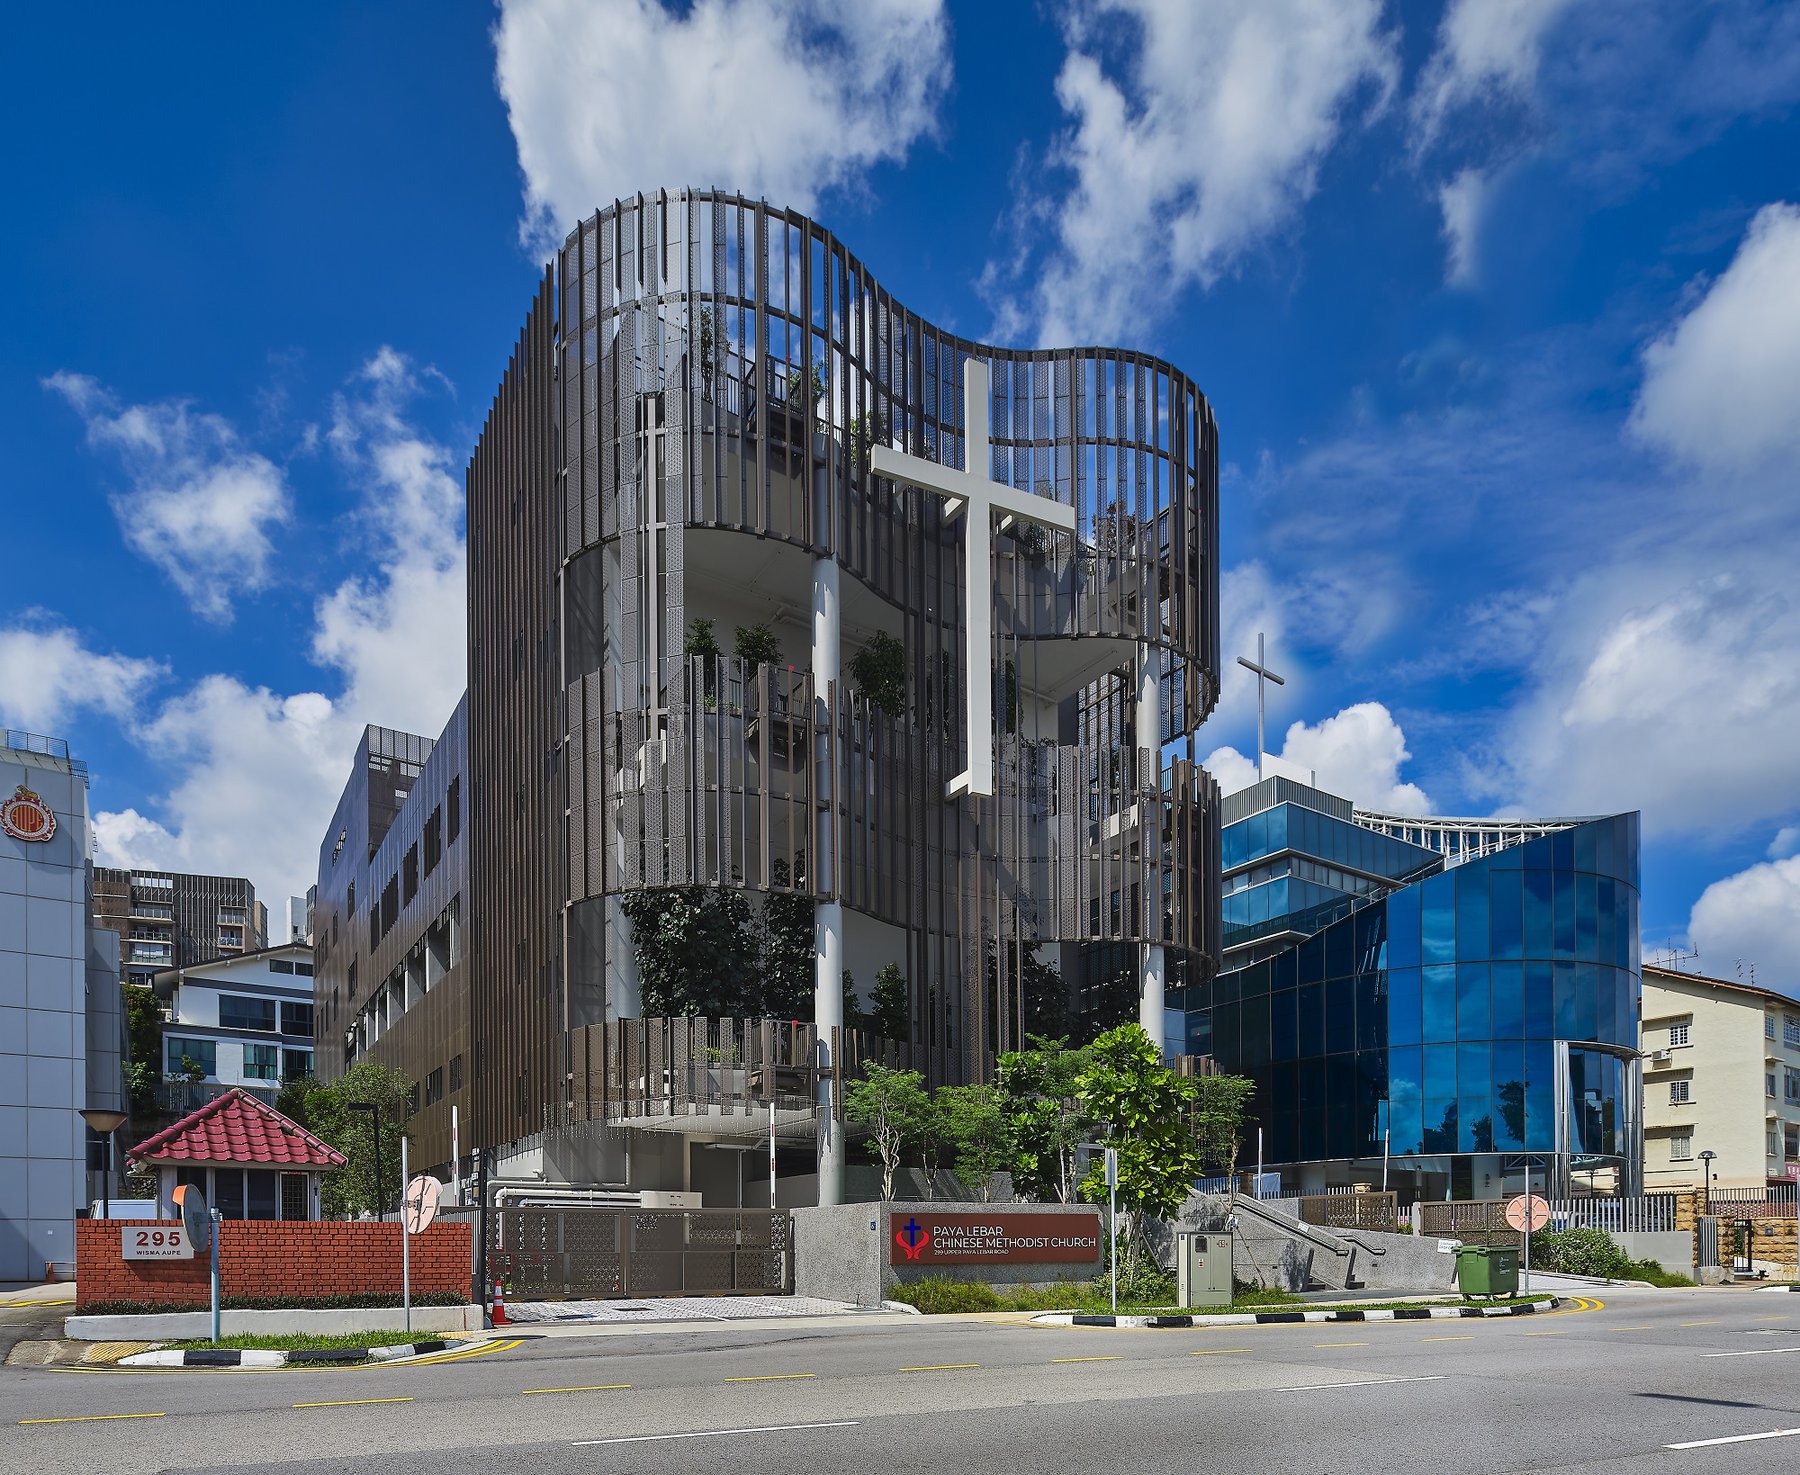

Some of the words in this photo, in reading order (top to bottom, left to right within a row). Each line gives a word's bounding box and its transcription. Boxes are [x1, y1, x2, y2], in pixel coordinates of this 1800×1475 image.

[933, 1226, 964, 1237] PAYA
[966, 1226, 1004, 1237] LEBAR
[136, 1231, 181, 1247] 295
[933, 1237, 984, 1249] CHINESE
[985, 1237, 1050, 1249] METHODIST
[1050, 1236, 1097, 1249] CHURCH
